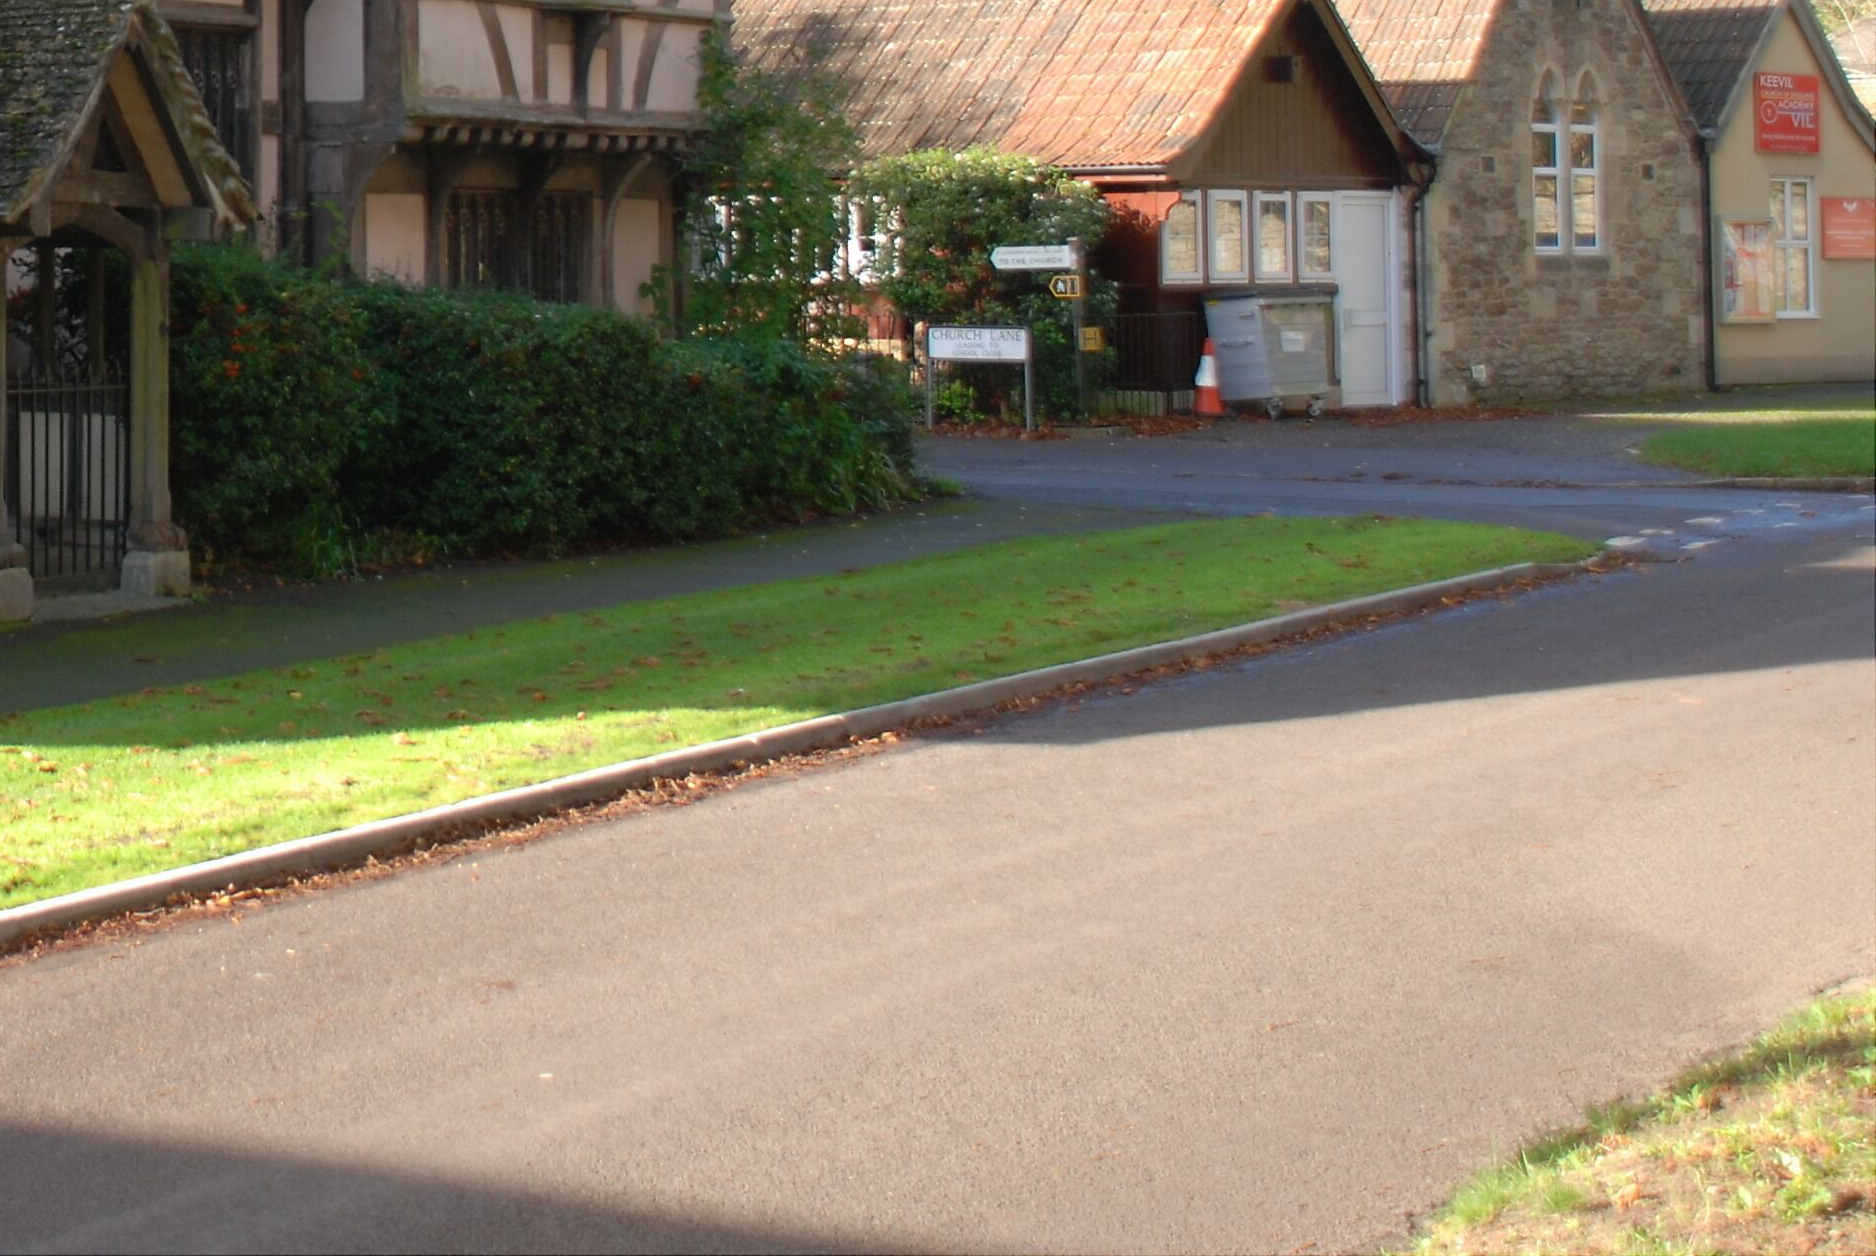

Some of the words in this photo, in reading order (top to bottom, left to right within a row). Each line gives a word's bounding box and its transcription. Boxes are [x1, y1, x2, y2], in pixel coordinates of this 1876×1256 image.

[1760, 74, 1794, 89] KEEVIL
[1778, 100, 1814, 109] ACADEMY
[1028, 256, 1063, 264] CHURCH
[931, 329, 982, 341] CHURCH
[990, 330, 1022, 342] LANE
